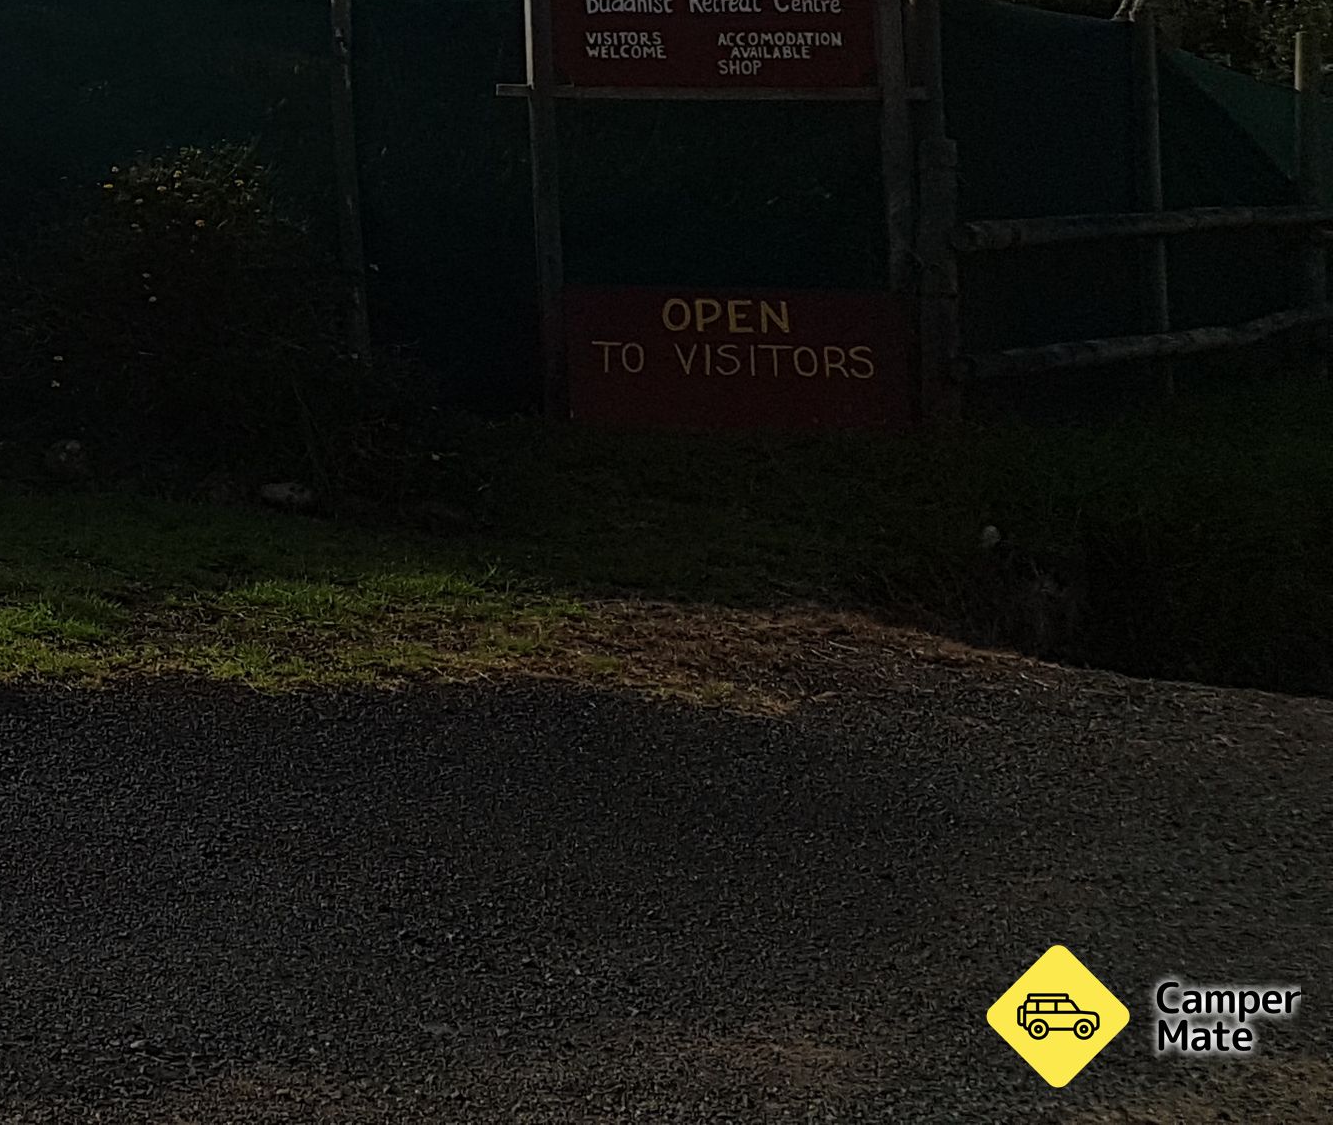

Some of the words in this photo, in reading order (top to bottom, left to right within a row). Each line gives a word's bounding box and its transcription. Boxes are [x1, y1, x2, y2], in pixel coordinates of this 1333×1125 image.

[585, 31, 663, 46] VISITORS
[717, 31, 843, 47] ACCOMODATION
[586, 45, 668, 59] WELCOME
[730, 46, 811, 60] AVAILABLE
[717, 59, 763, 75] SHOP
[661, 297, 791, 334] OPEN
[591, 339, 646, 374] TO
[674, 341, 875, 379] VISITORS
